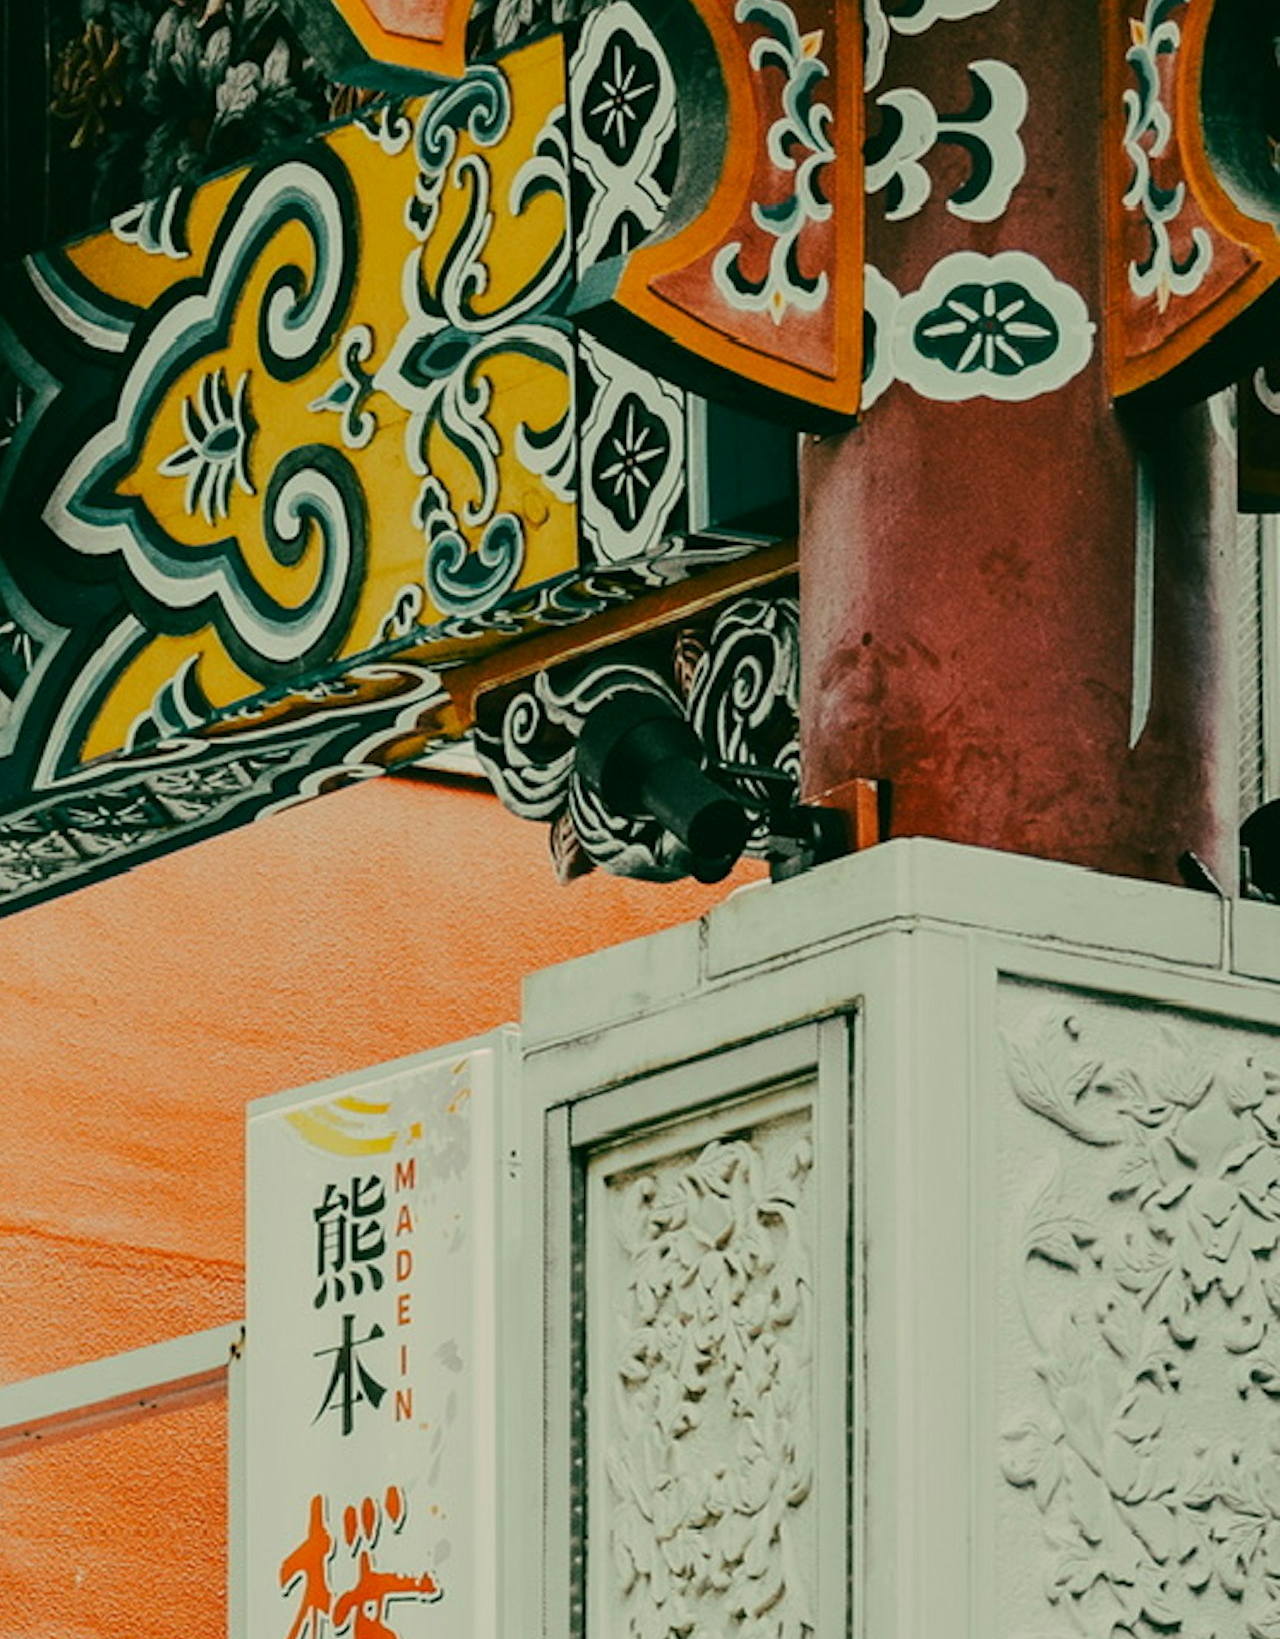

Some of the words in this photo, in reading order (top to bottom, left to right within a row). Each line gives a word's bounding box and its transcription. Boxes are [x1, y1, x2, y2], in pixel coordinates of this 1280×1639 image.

[311, 1174, 389, 1437] 熊本
[395, 1158, 417, 1327] MADE
[395, 1344, 414, 1423] IN
